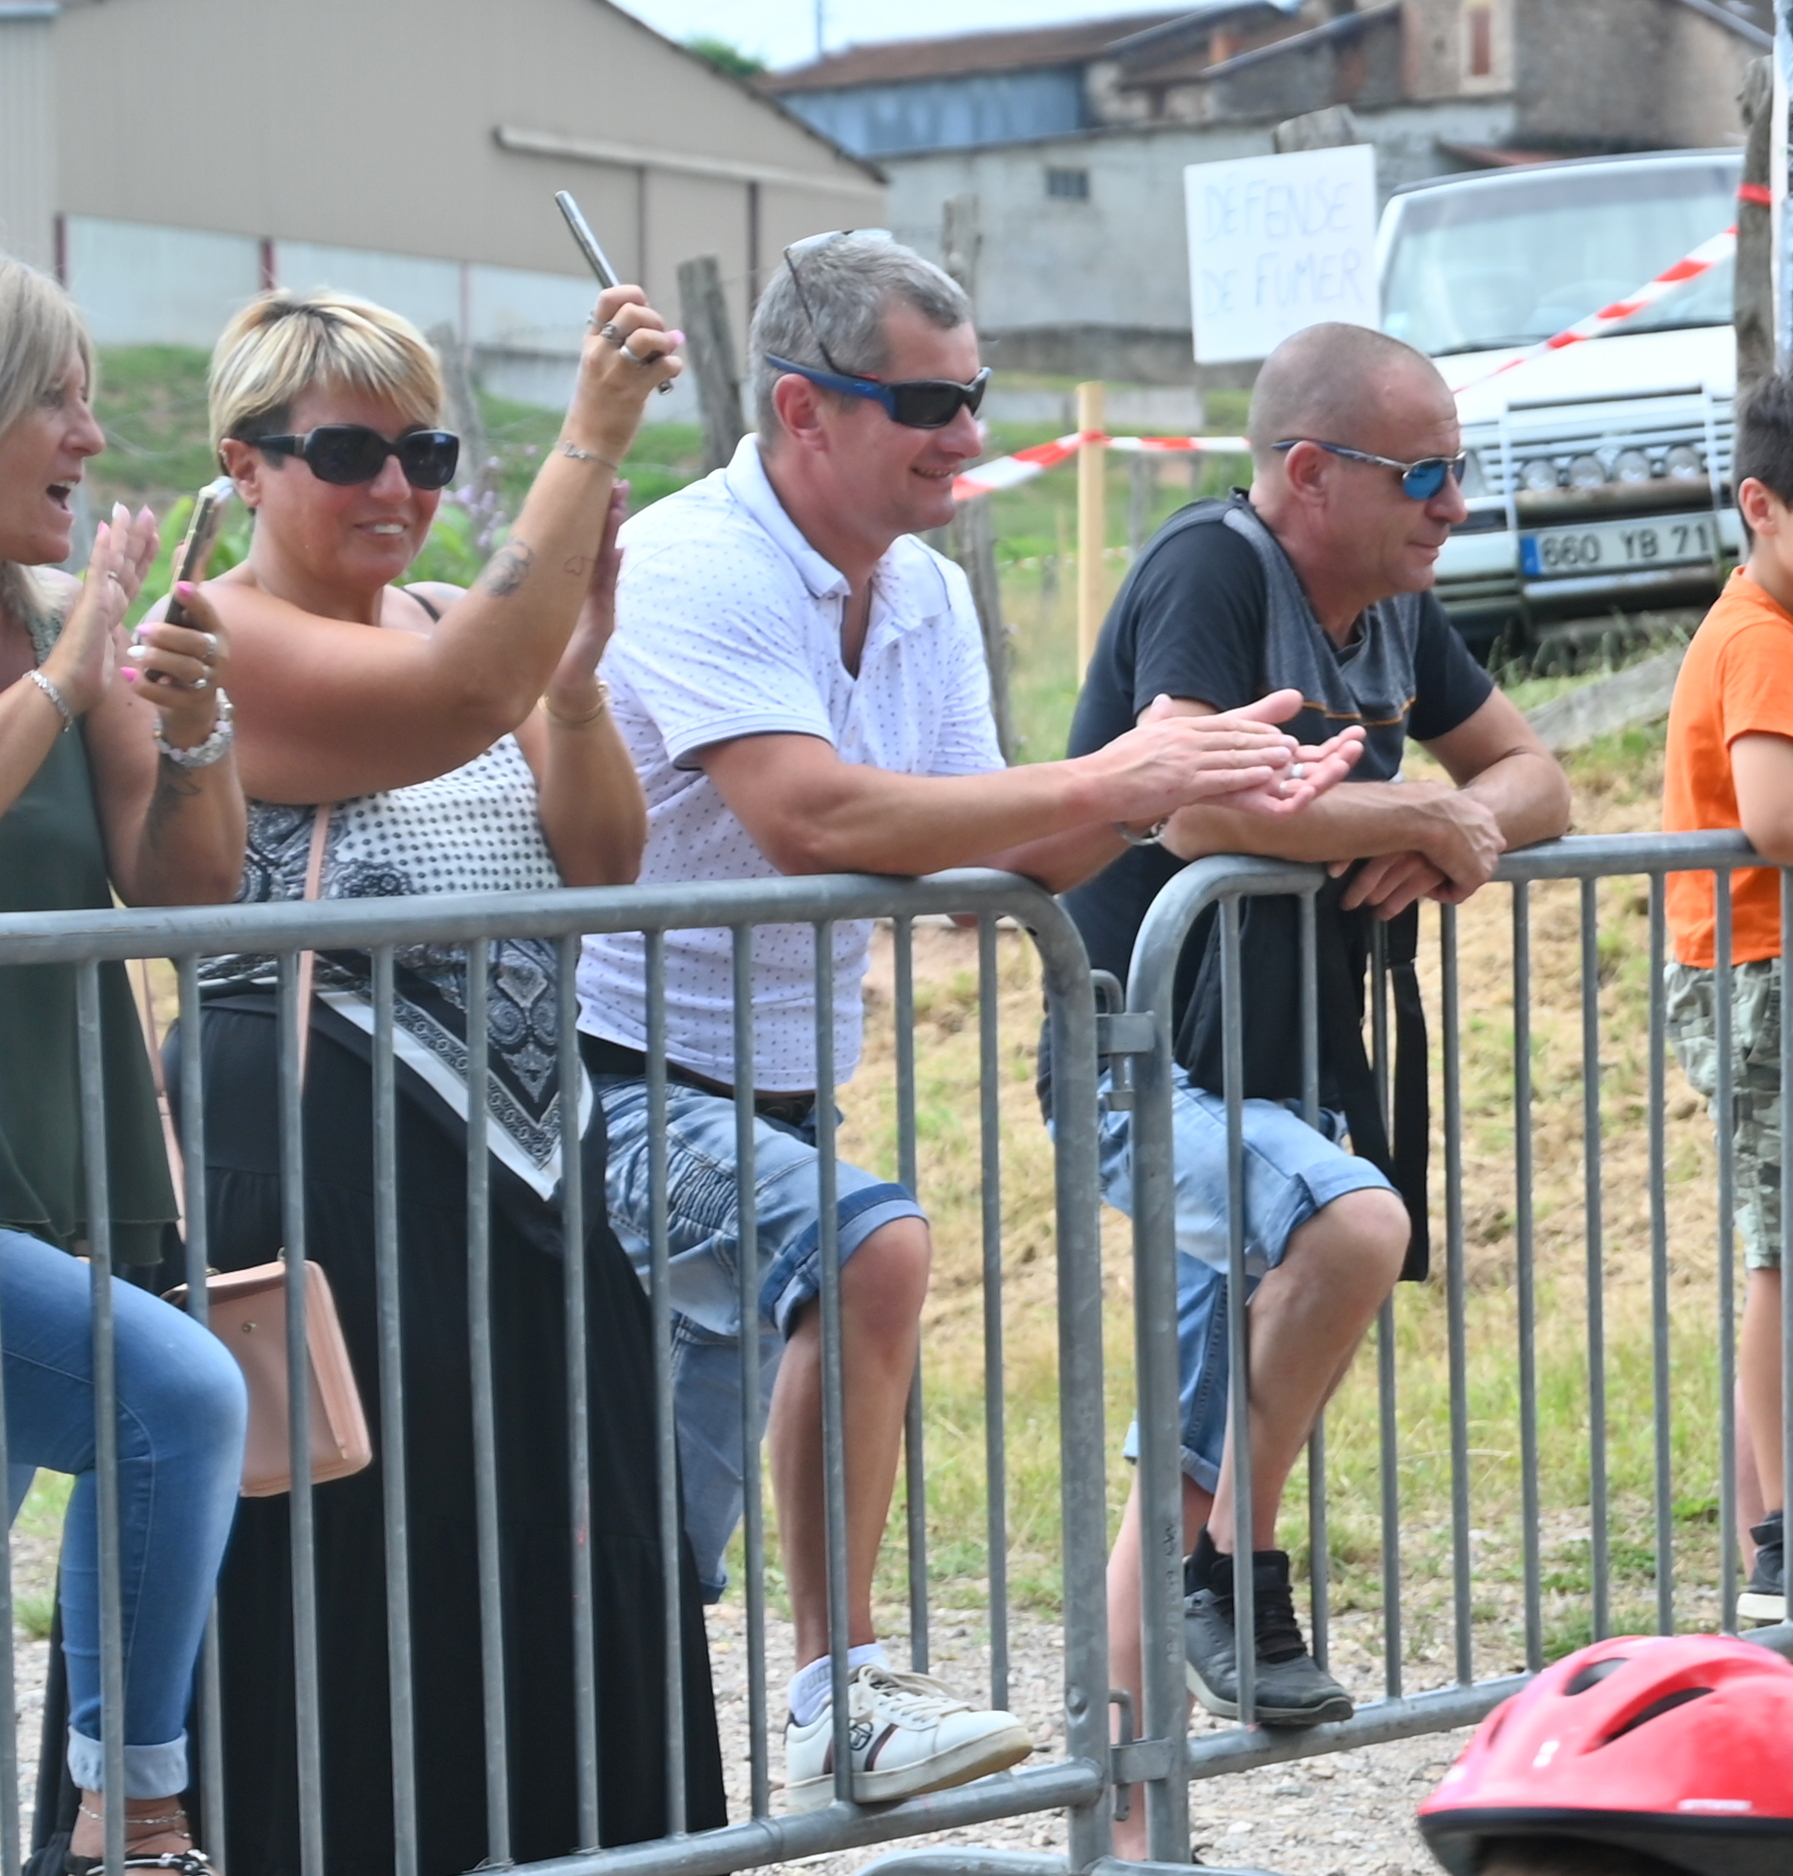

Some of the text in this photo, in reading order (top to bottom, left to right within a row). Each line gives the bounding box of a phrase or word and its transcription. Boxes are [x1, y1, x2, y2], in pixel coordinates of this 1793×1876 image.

[1200, 247, 1365, 317] DE FUMER
[1541, 523, 1711, 567] 660 YB 71
